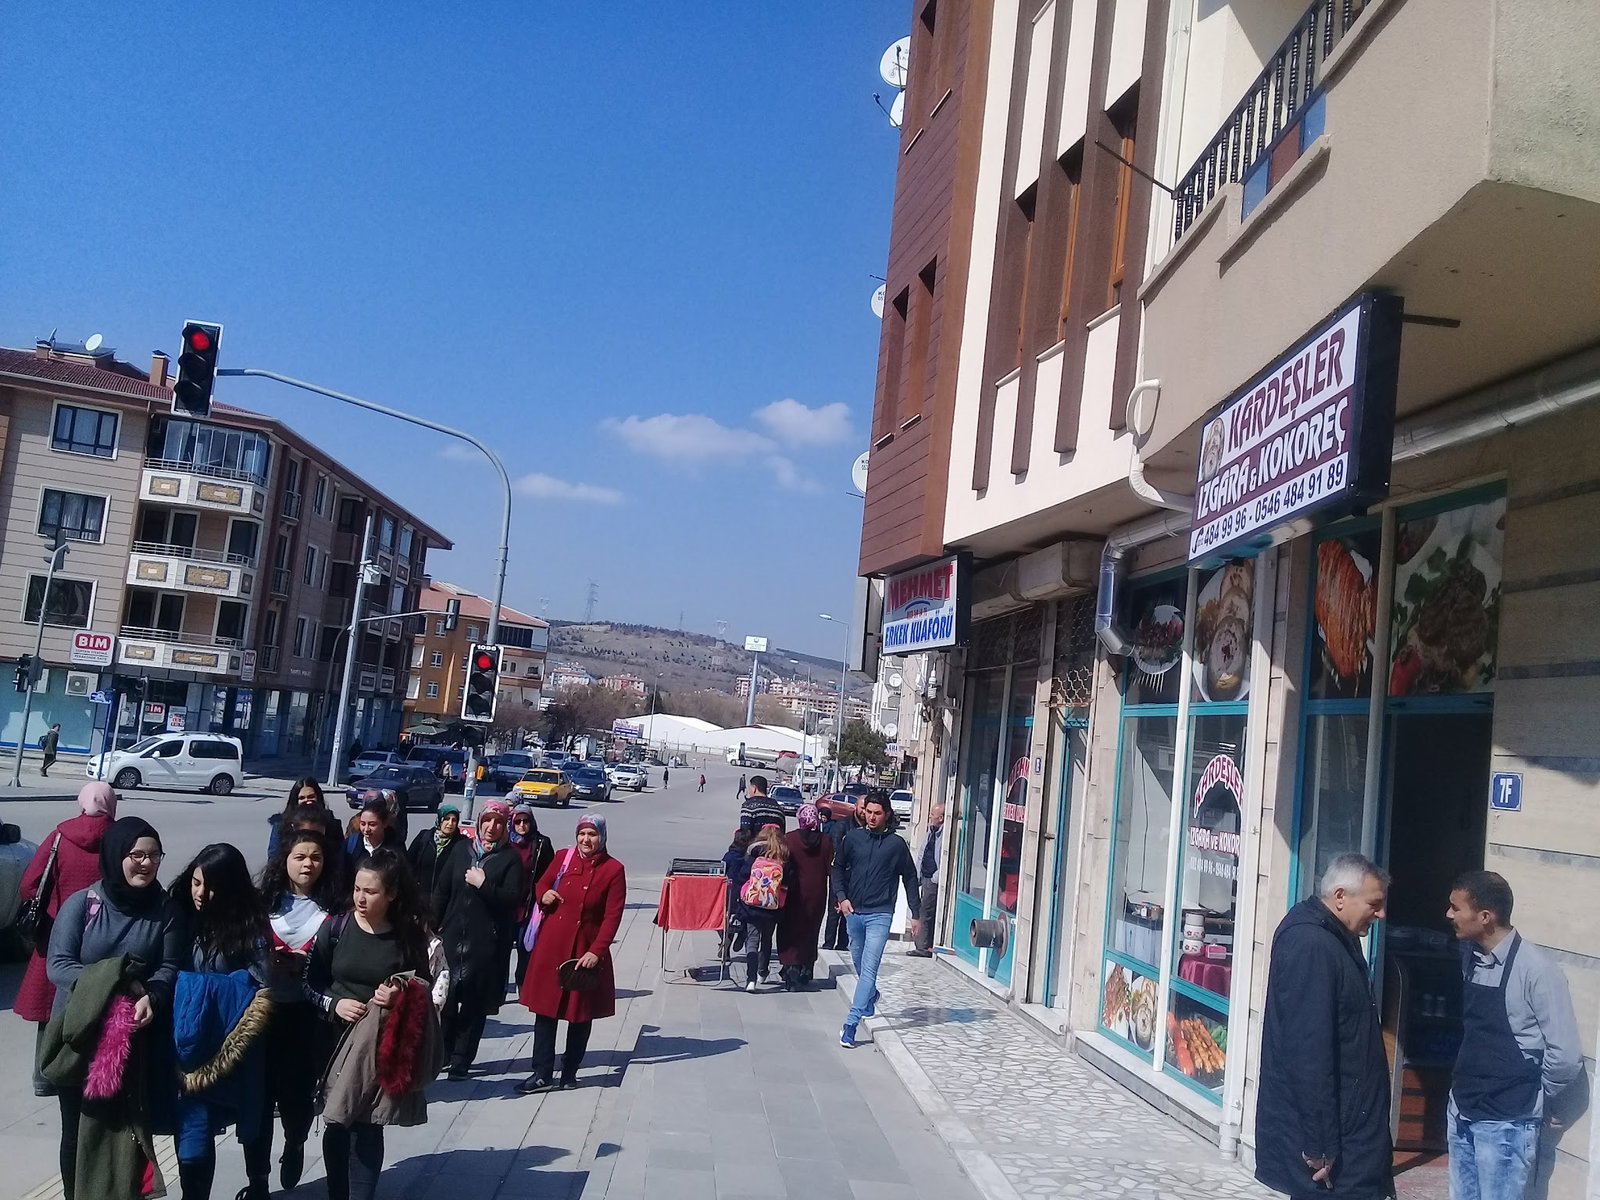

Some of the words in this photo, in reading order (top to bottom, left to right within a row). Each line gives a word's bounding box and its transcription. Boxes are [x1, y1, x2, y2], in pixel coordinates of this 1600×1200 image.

[1227, 327, 1346, 454] KARDEŞLER
[1196, 456, 1251, 521] IZGARA
[1249, 467, 1258, 492] &
[1257, 396, 1348, 487] KOKOREÇ
[1203, 521, 1221, 547] 484
[1221, 514, 1233, 540] 99
[1234, 507, 1248, 533] 96
[1254, 490, 1281, 523] 0546
[1283, 478, 1305, 509] 484
[1308, 468, 1323, 499] 91
[1327, 458, 1344, 490] 89
[887, 564, 954, 615] MEHMET
[884, 621, 910, 647] ERKEK
[910, 606, 954, 643] KUAFÖRÜ
[1500, 777, 1513, 804] 7F
